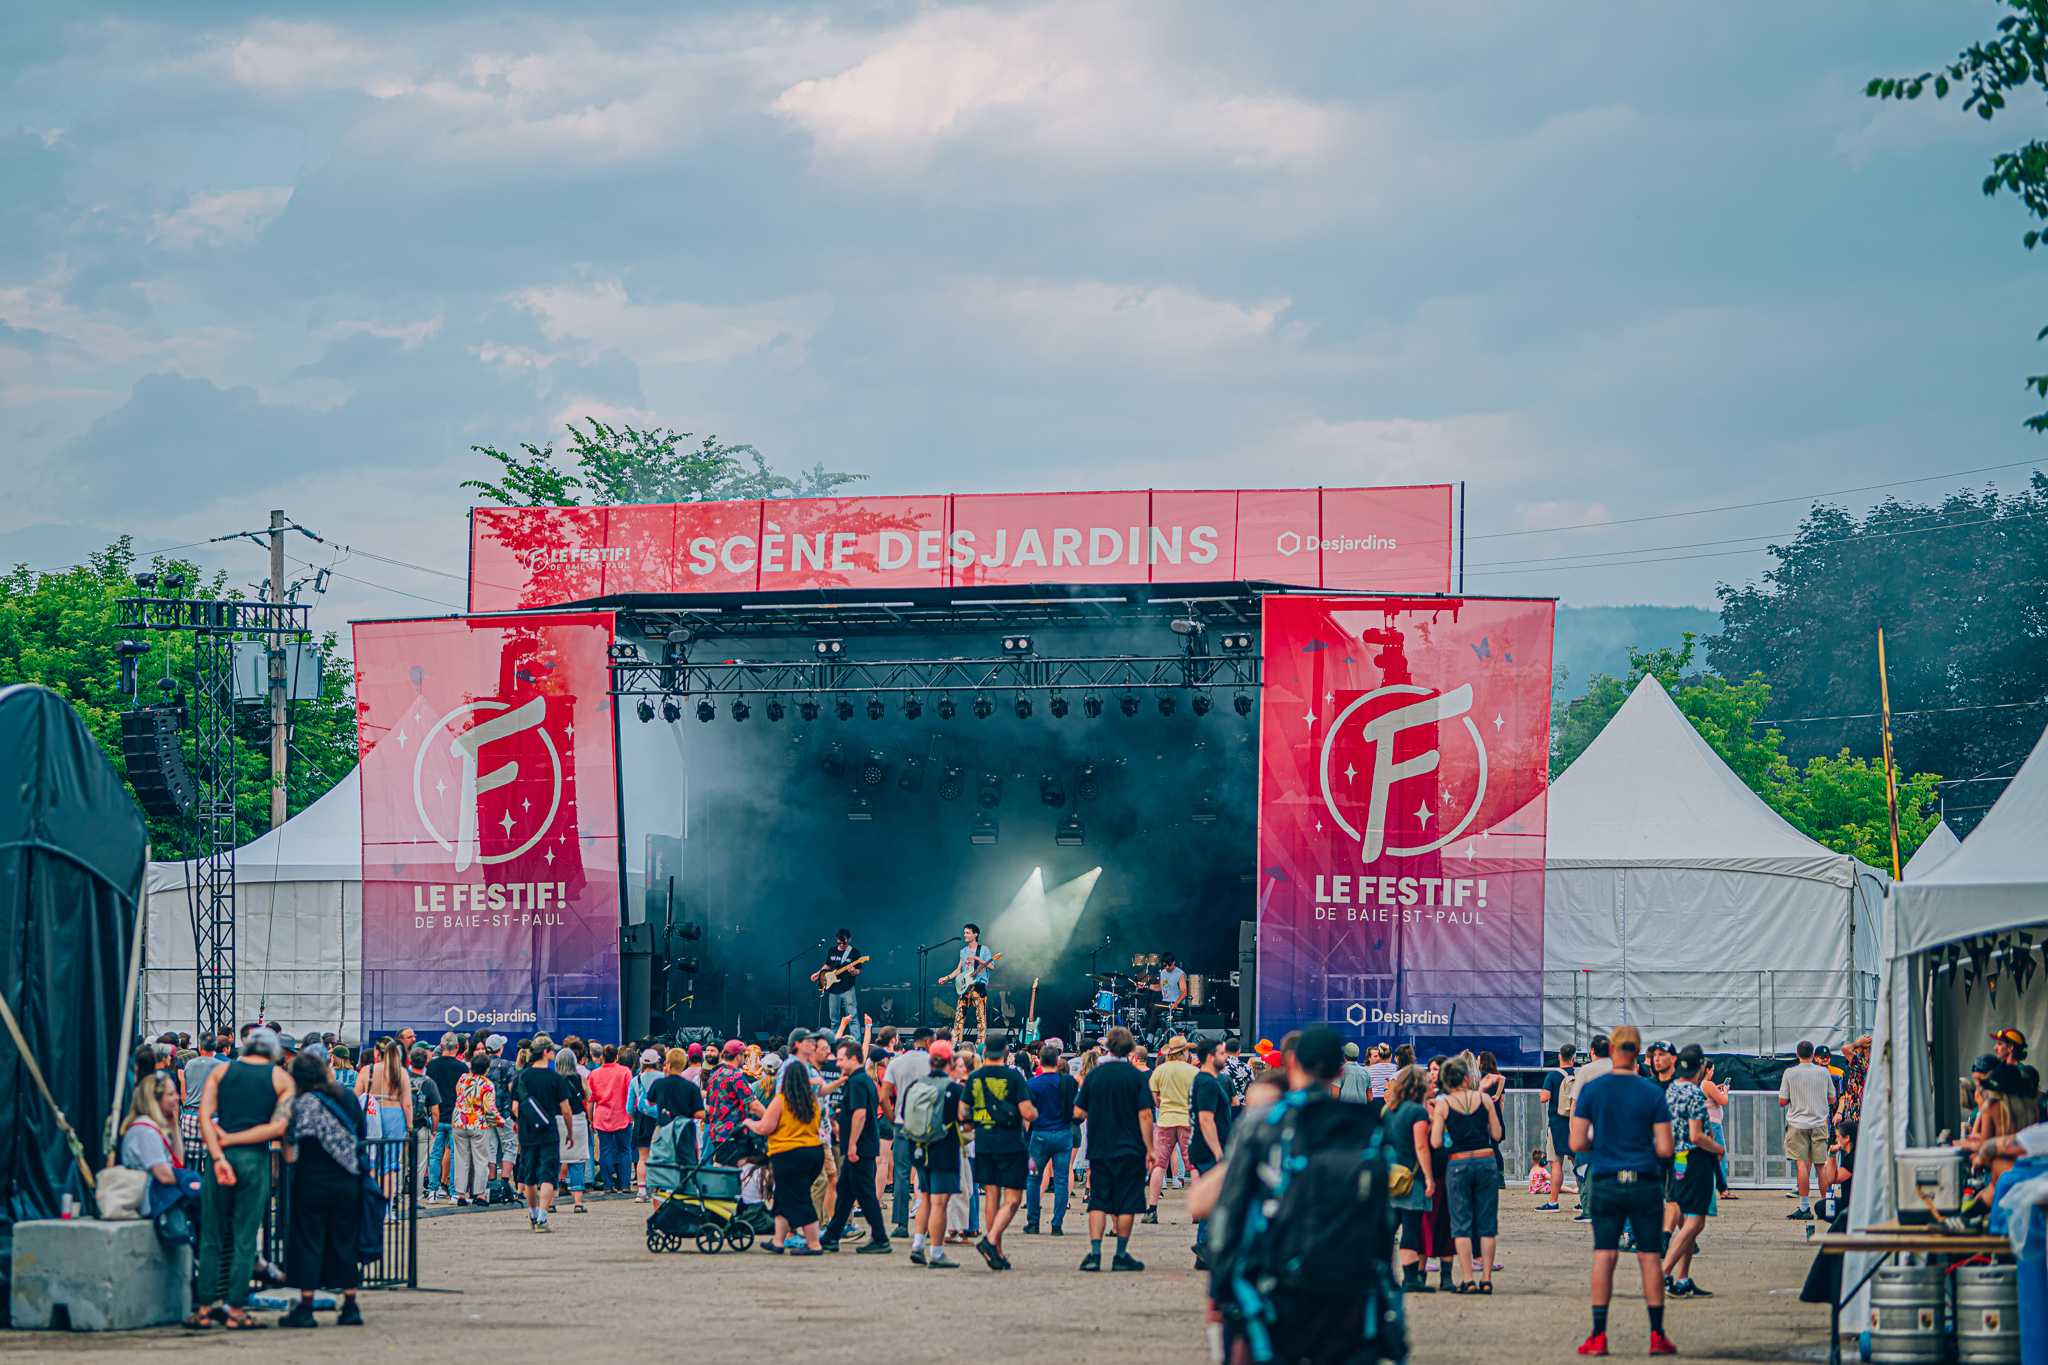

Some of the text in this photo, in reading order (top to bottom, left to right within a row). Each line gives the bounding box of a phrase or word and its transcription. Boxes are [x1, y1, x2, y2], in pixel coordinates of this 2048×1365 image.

[688, 519, 1219, 575] SCÈNE DESJARDINS
[1305, 533, 1398, 554] Desjardins
[550, 546, 630, 562] LE FESTIF!
[414, 881, 567, 912] LE FESTIF!
[1315, 875, 1488, 908] LE FESTIF!
[415, 912, 565, 929] DE BAIE-ST-PAUL
[1315, 907, 1484, 925] DE BAIE-ST-PAUL
[467, 1007, 537, 1024] Desjardins
[1371, 1007, 1449, 1026] Desjardins
